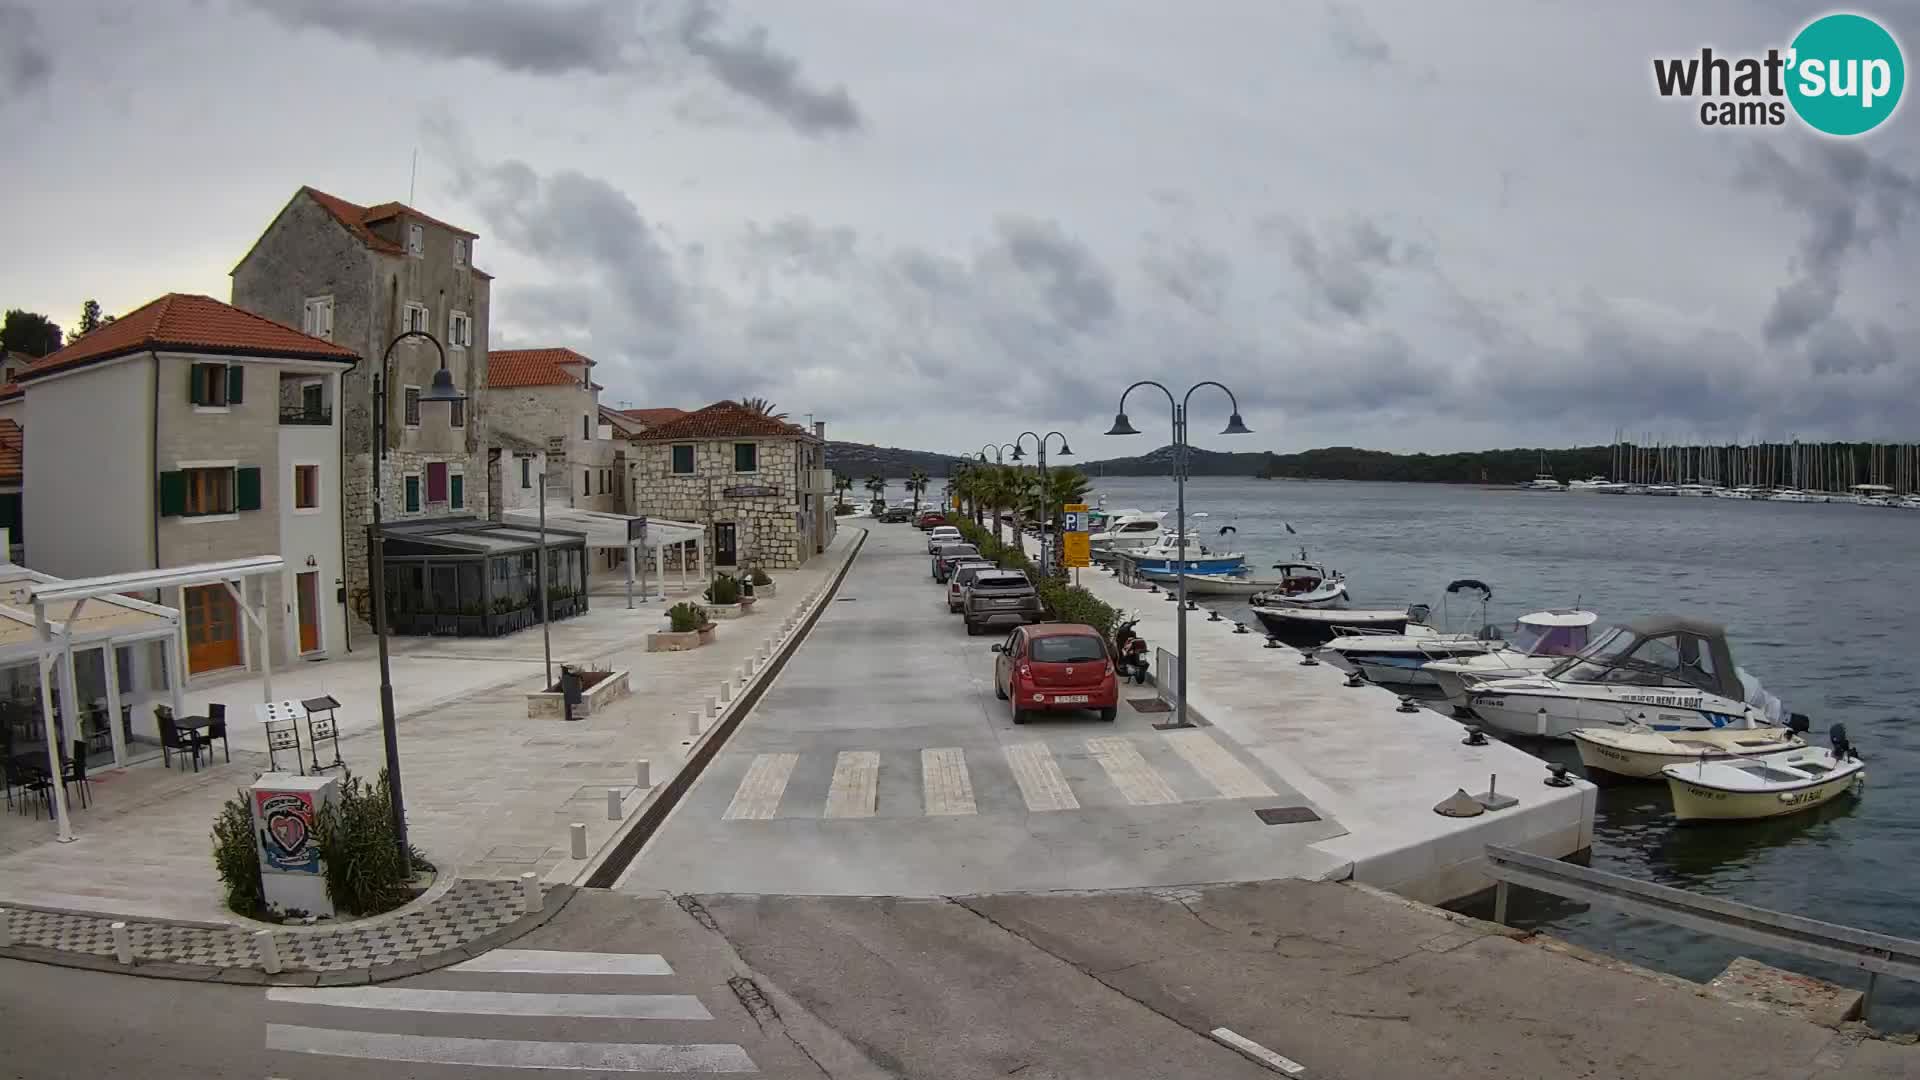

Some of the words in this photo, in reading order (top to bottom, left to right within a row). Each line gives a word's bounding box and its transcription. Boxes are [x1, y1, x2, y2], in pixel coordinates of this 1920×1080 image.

[1066, 514, 1076, 530] P
[1656, 696, 1676, 706] RENT
[1677, 697, 1682, 707] A
[1684, 697, 1703, 709] BOAT
